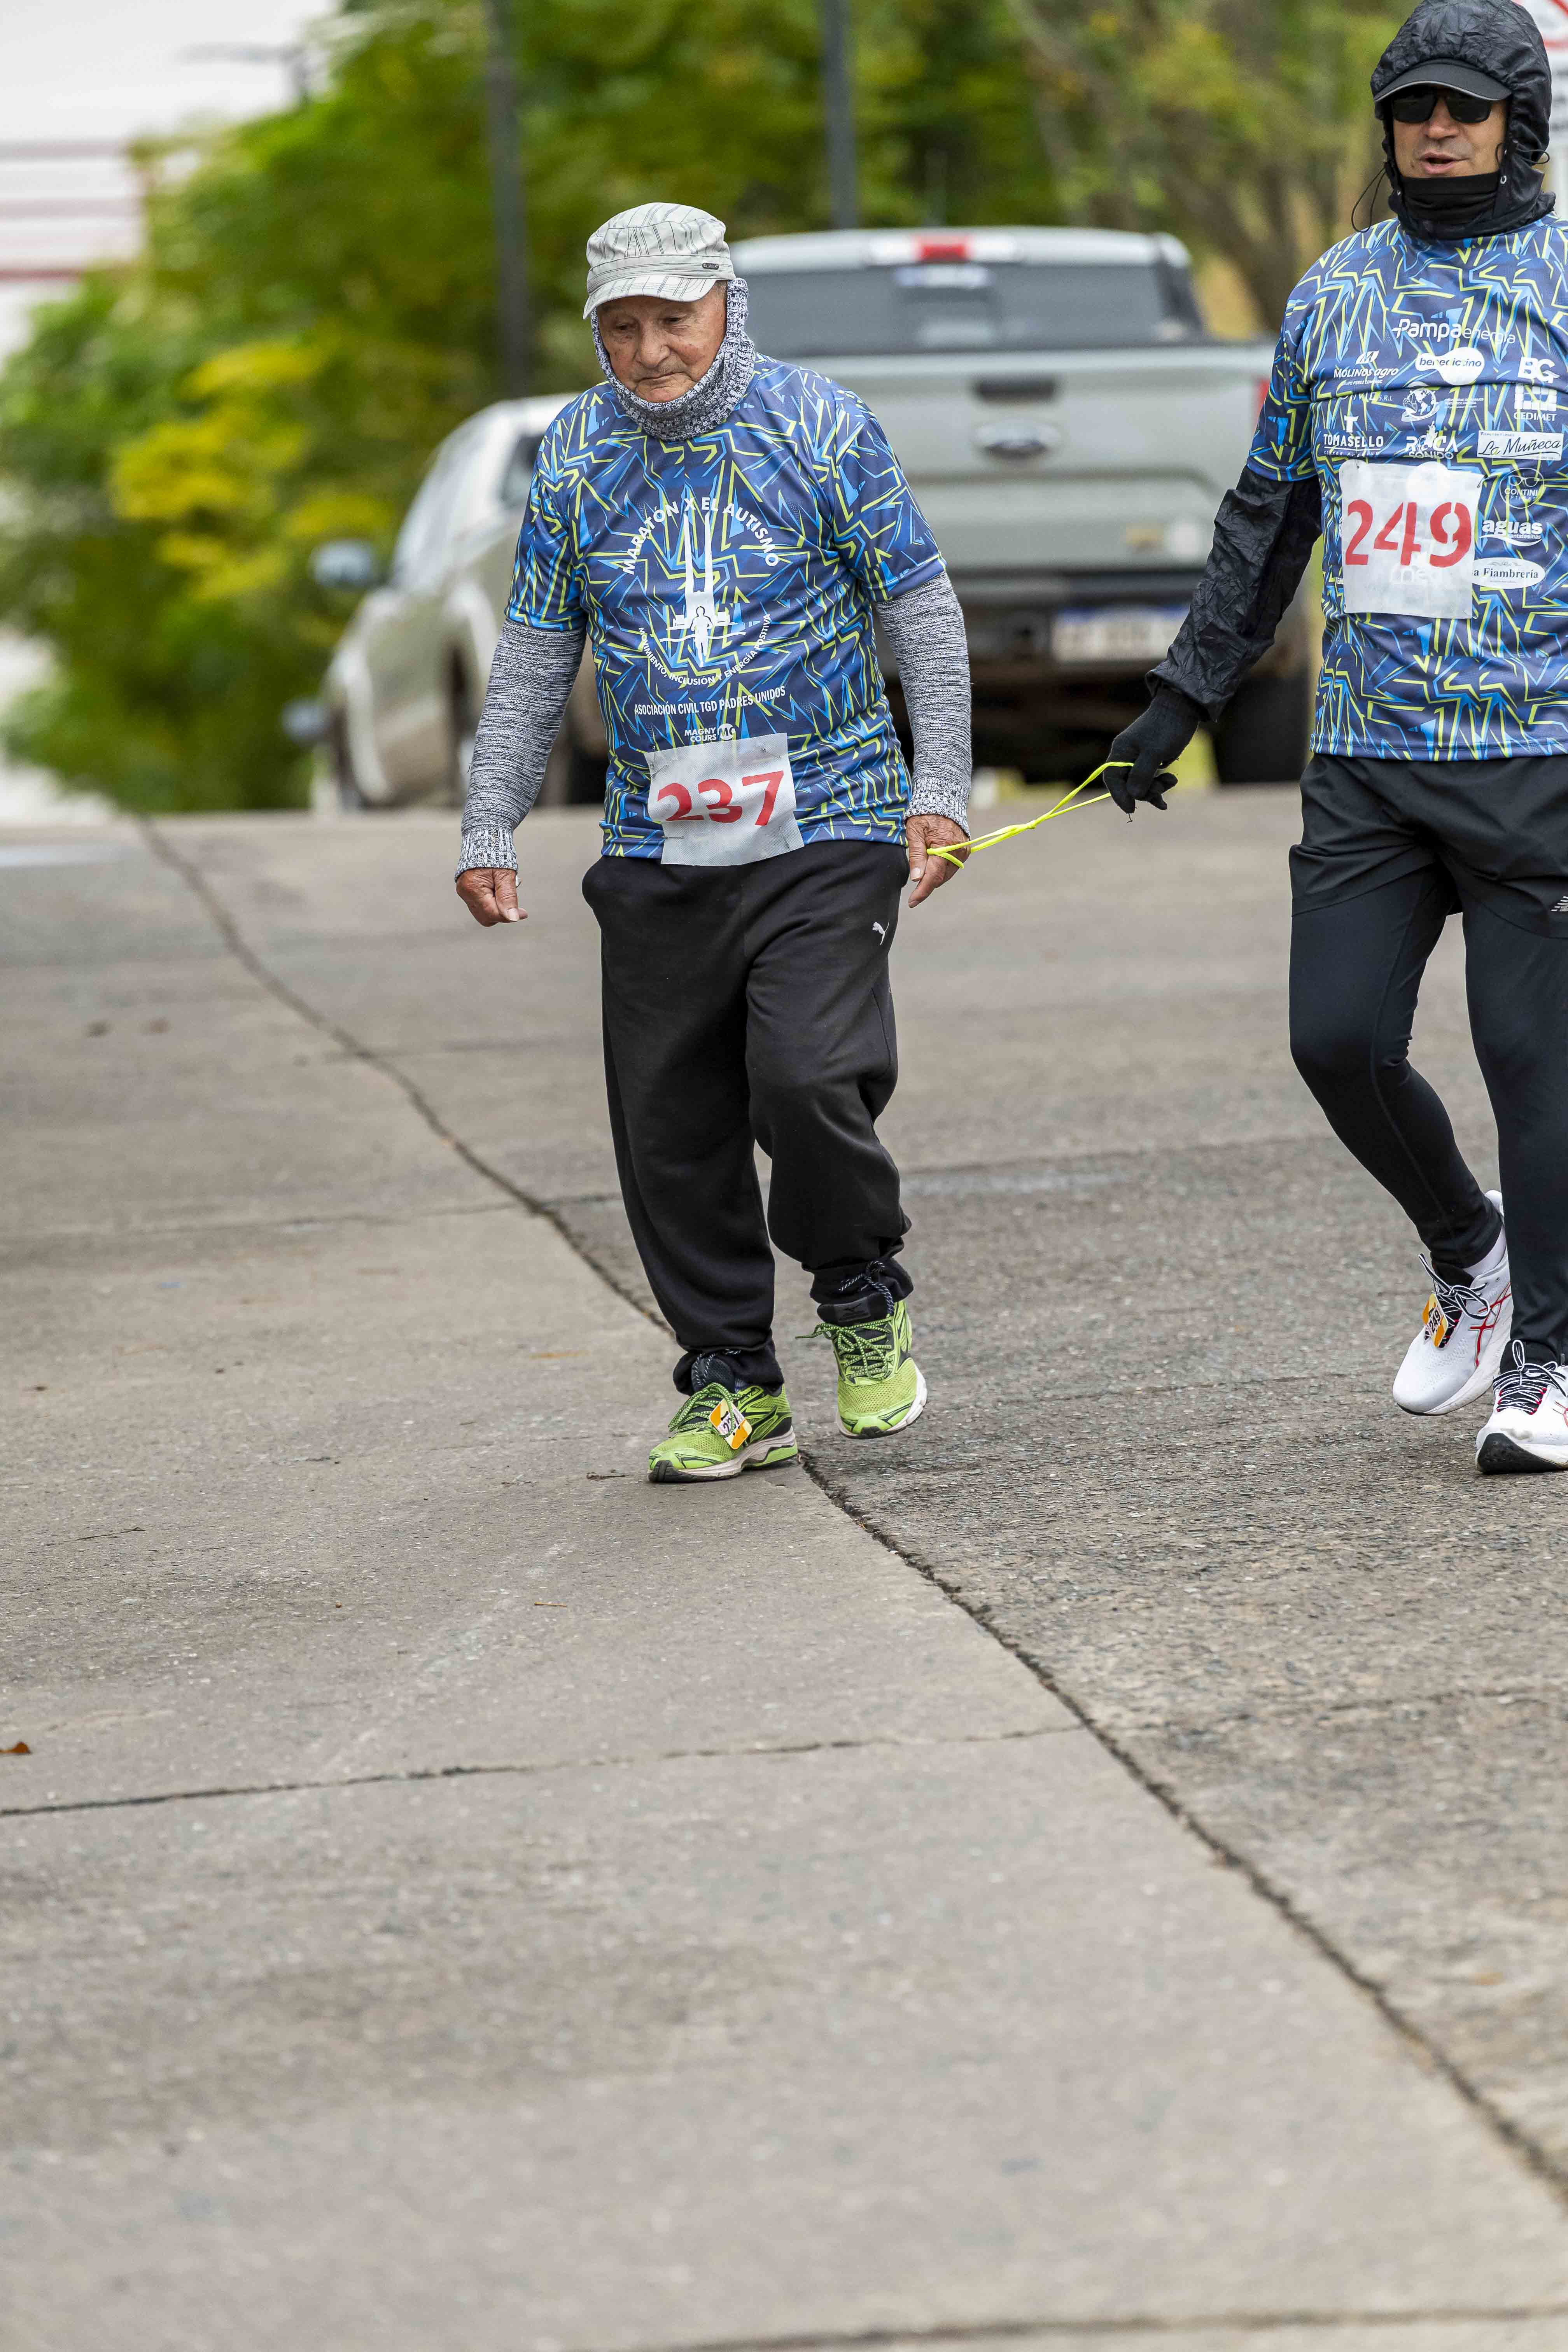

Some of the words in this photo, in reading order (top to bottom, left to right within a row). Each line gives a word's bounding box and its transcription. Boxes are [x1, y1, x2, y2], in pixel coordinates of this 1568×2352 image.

[1419, 357, 1482, 367] benedicino
[1334, 369, 1372, 379] MOLINOS
[1373, 368, 1399, 378] agro
[1513, 411, 1557, 422] CEDIMET
[1323, 433, 1384, 448] TOMASELLO
[1478, 441, 1500, 455] La
[1503, 436, 1562, 455] Muñeca
[1408, 450, 1454, 460] SONIDO
[1504, 488, 1538, 497] CONTINI
[1345, 499, 1472, 568] 249
[1482, 520, 1544, 536] aguas
[622, 501, 679, 575] MARATÓN
[683, 497, 696, 511] X
[701, 497, 719, 512] EL
[722, 503, 779, 567] AUTISMO
[1483, 567, 1538, 579] Fiambrería
[638, 627, 668, 677] MOVIMIENTO,
[668, 672, 716, 686] INCLUSIÓN
[723, 650, 758, 678] ENERGÍA
[752, 613, 771, 651] POSITIVA
[634, 701, 677, 716] ASOCIACIÓN
[678, 702, 699, 715] CIVIL
[699, 701, 718, 713] TGD
[719, 695, 753, 710] PADRES
[754, 685, 786, 704] UNIDOS
[684, 727, 717, 736] MAGNY
[690, 734, 717, 742] COURS
[657, 770, 784, 826] 237
[1429, 1309, 1441, 1334] 249
